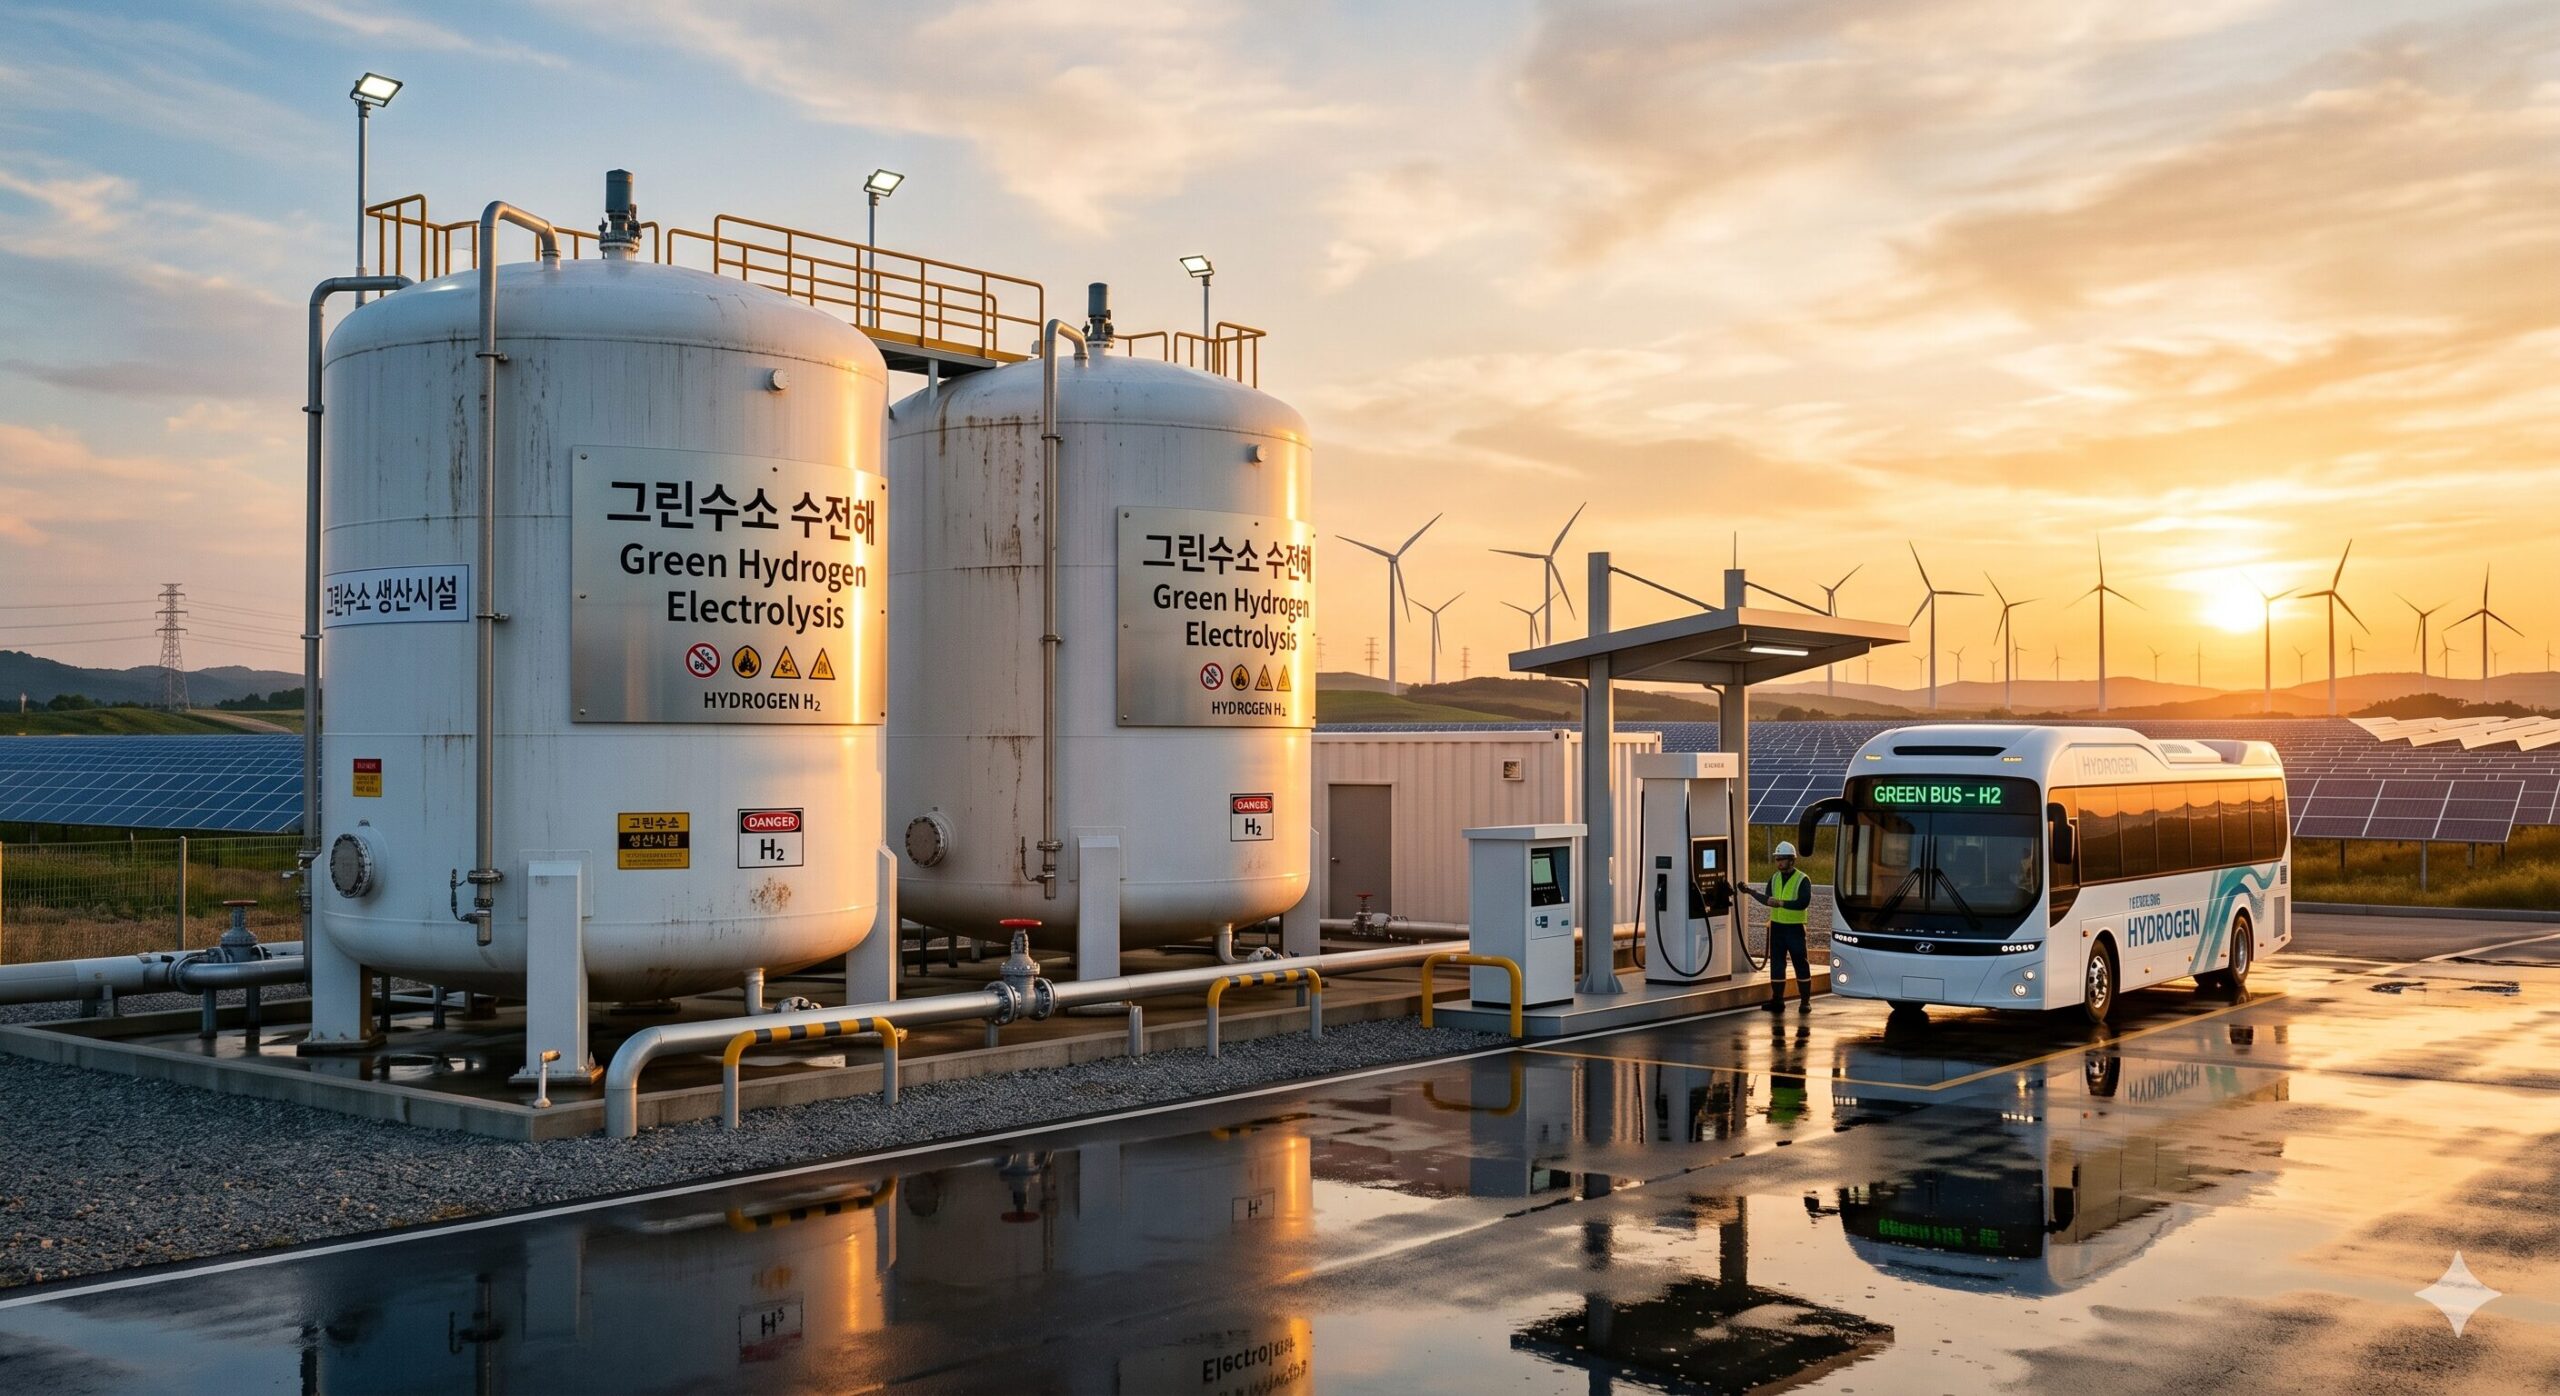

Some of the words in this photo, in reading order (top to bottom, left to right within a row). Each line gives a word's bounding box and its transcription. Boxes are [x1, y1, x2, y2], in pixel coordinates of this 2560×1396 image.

[607, 480, 779, 532] 그린수소
[791, 491, 875, 546] 수전해
[620, 543, 727, 578] Green
[739, 548, 866, 593] Hydrogen
[1143, 533, 1259, 575] 그린수소
[1266, 541, 1312, 583] 수전해
[376, 575, 457, 613] 생산시설
[668, 590, 844, 635] Electrolysis
[1153, 583, 1227, 611] Green
[1235, 588, 1310, 624] Hydrogen
[1186, 620, 1297, 656] Electrolysis
[704, 691, 799, 710] HYDROGEN
[2082, 756, 2138, 776] HYDROGEN
[1874, 786, 1927, 803] GREEN
[1930, 786, 1962, 803] BUS
[1979, 786, 2001, 804] H2
[750, 816, 795, 828] DANGER
[2128, 907, 2200, 948] HYDROGEN
